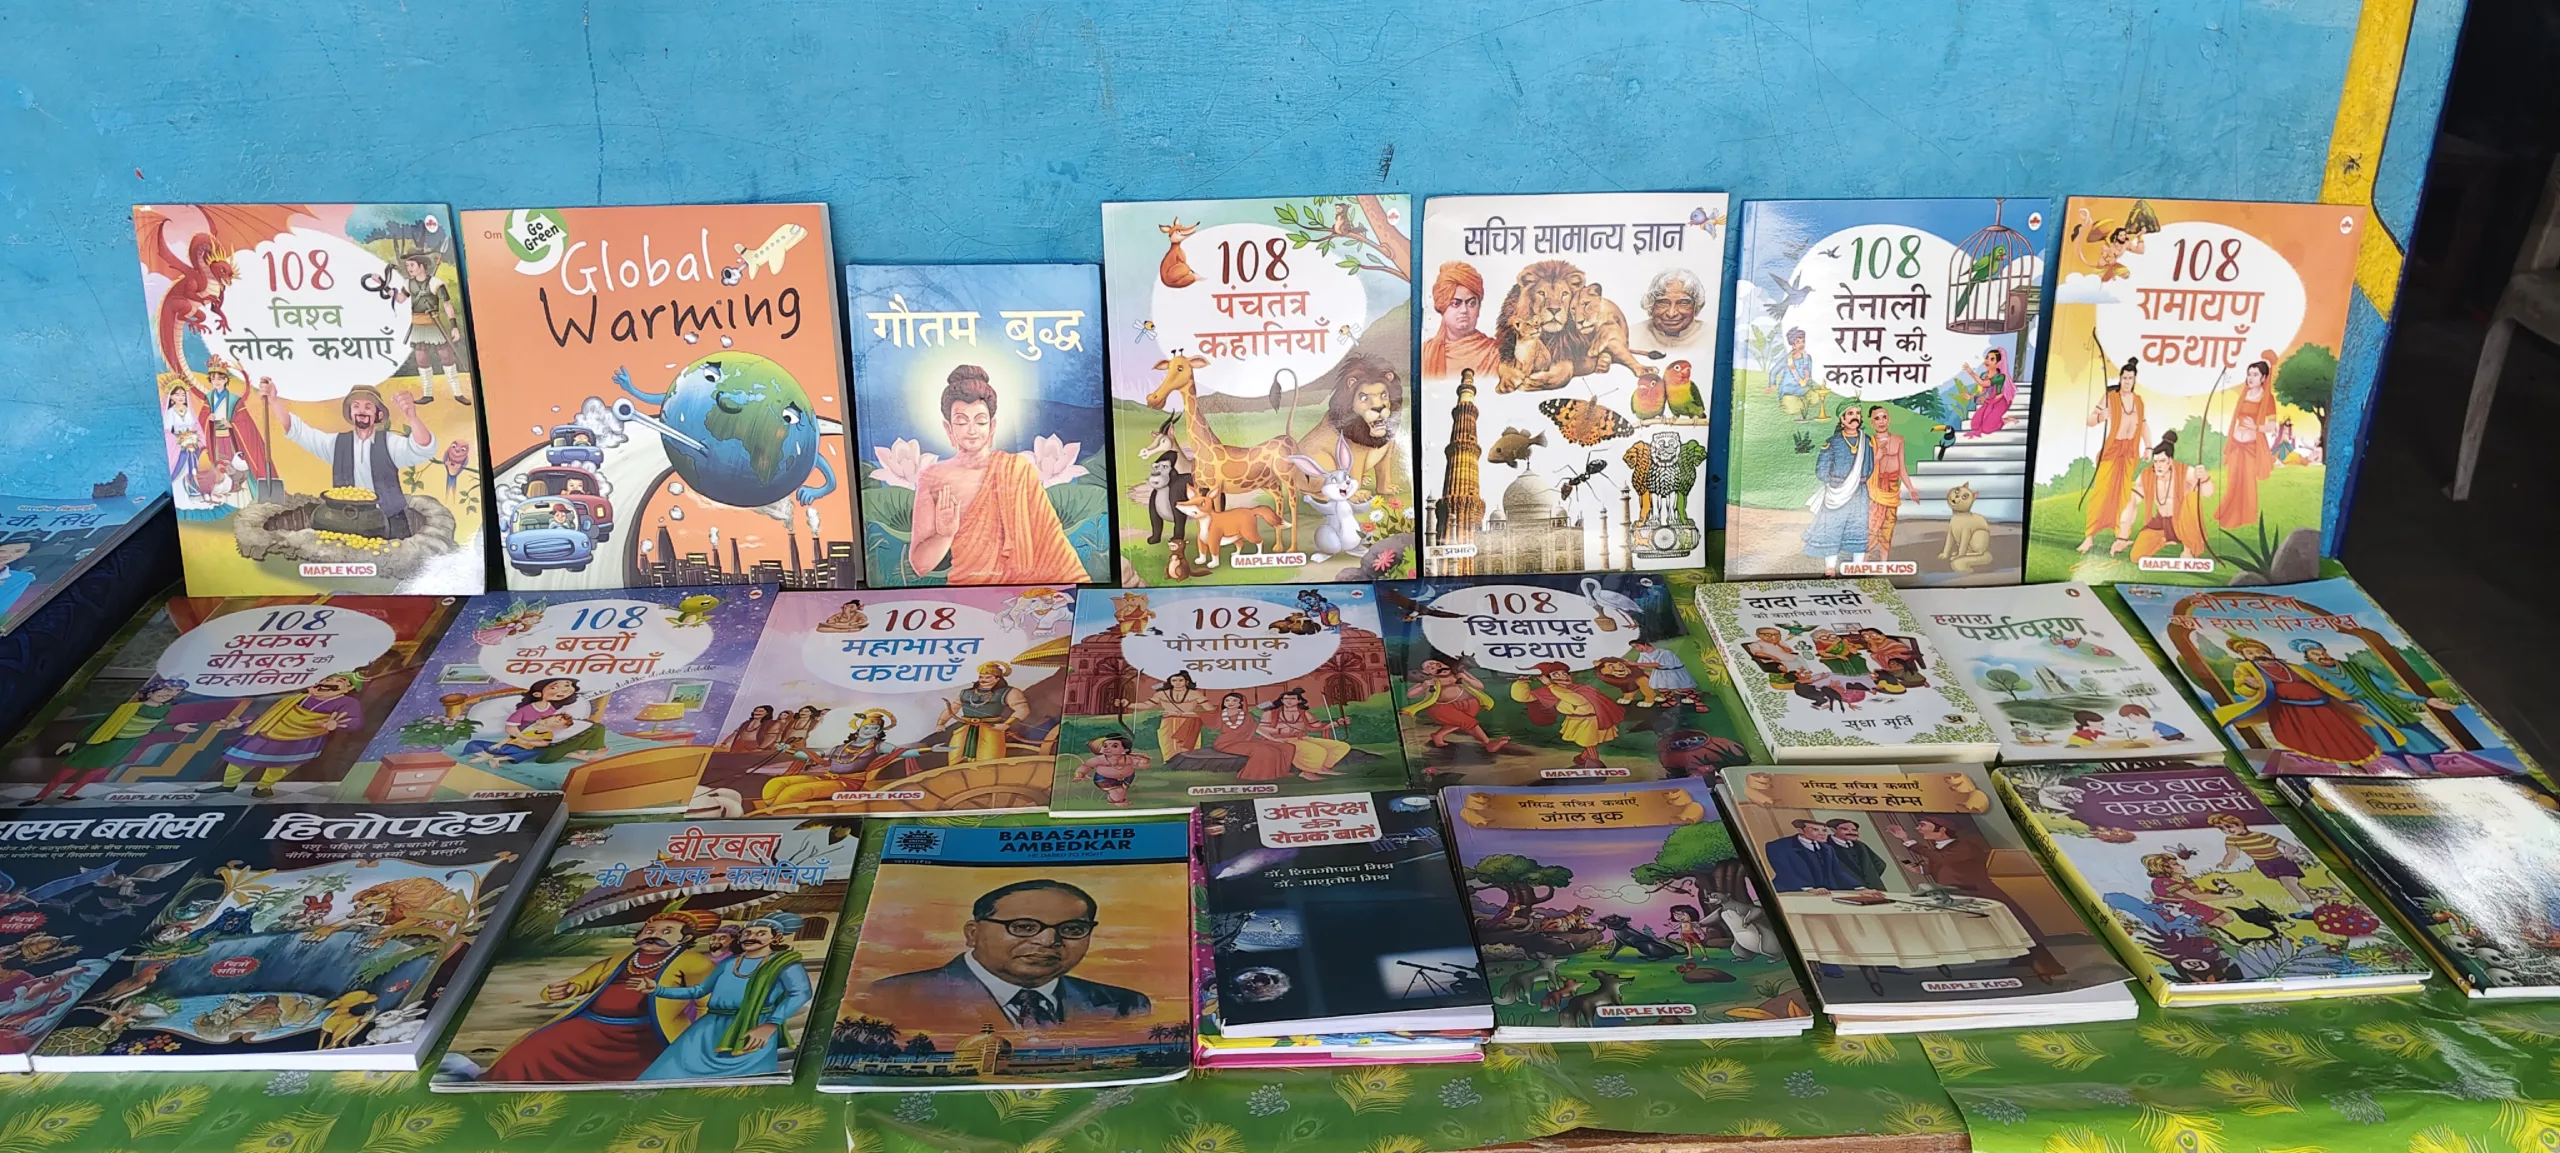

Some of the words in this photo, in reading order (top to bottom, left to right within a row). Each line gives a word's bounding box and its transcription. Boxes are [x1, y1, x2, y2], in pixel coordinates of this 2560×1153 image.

[484, 231, 503, 240] Om
[524, 225, 560, 251] Green
[527, 222, 543, 236] Go
[1464, 216, 1526, 256] सचित्र
[1534, 222, 1626, 255] सामान्य
[1632, 222, 1686, 254] ज्ञान
[560, 227, 714, 297] Global
[1217, 237, 1290, 284] 108
[1850, 234, 1922, 281] 108
[2172, 238, 2242, 283] 108
[262, 249, 336, 293] 108
[1211, 283, 1311, 319] पंचतंत्र
[1833, 282, 1932, 321] तेनाली
[2136, 287, 2265, 323] रामायण
[268, 297, 344, 329] विश्व
[539, 287, 801, 347] Warming
[866, 293, 981, 349] गौतम
[999, 310, 1086, 361] बुद्ध
[1194, 316, 1330, 361] कहानियाँ
[224, 328, 294, 362] लोक
[308, 325, 399, 368] कथाएँ
[1831, 327, 1886, 353] राम
[1894, 326, 1927, 353] की
[2140, 324, 2251, 370] कथाएँ
[1823, 353, 1933, 388] कहानियाँ
[303, 565, 342, 576] MAPLE
[346, 565, 375, 576] KIDS
[1235, 555, 1274, 566] MAPLE
[1276, 554, 1304, 566] KIDS
[1844, 564, 1884, 575] MAPLE
[1886, 564, 1914, 574] KIDS
[2142, 559, 2181, 570] MAPLE
[2184, 560, 2212, 571] KIDS
[1484, 591, 1559, 615] 108
[1744, 589, 1863, 611] दादा-दादी
[2190, 592, 2303, 613] बीरबल
[257, 609, 336, 633] 108
[570, 605, 649, 631] 108
[885, 607, 957, 633] 108
[1192, 606, 1261, 631] 108
[1464, 614, 1596, 637] शिक्षाप्रद
[1931, 614, 1994, 627] हमारा
[1951, 616, 2088, 641] पर्यावरण
[2207, 617, 2259, 632] हास
[2260, 614, 2362, 632] परिहास
[224, 632, 339, 650] अकबर
[516, 645, 549, 657] की
[555, 631, 638, 653] बच्चों
[842, 637, 985, 657] महाभारत
[1163, 633, 1292, 652] पौराणिक
[1484, 636, 1589, 659] कथाएँ
[206, 650, 307, 670] बीरबल
[312, 654, 335, 665] की
[505, 651, 664, 676] कहानियाँ
[851, 658, 966, 683] कथाएँ
[1182, 652, 1273, 676] कथाएँ
[195, 667, 318, 688] कहानियाँ
[1841, 718, 1877, 732] सुधा
[1883, 714, 1914, 729] मूर्ति
[1545, 769, 1591, 779] MAPLE
[1594, 768, 1628, 778] KIDS
[836, 792, 883, 801] MAPLE
[887, 791, 922, 800] KIDS
[1192, 786, 1239, 795] MAPLE
[1242, 784, 1275, 794] KIDS
[1800, 781, 1838, 791] प्रसिद्ध
[1843, 780, 1879, 791] सचित्र
[1884, 779, 1923, 792] कथाएँ
[2086, 777, 2164, 797] श्रेष्ठ
[2166, 777, 2236, 796] बाल
[109, 793, 158, 802] MAPLE
[160, 793, 197, 801] KIDS
[1518, 799, 1556, 811] प्रसिद्ध
[1560, 798, 1596, 810] सचित्र
[1603, 796, 1640, 808] कथाएँ
[1882, 793, 1923, 808] होम्स
[2100, 791, 2258, 817] कहानियाँ
[1264, 800, 1368, 820] अंतरिक्ष
[1539, 811, 1585, 824] जंगल
[1590, 810, 1624, 824] बुक
[91, 812, 225, 840] बत्तीसी
[260, 811, 533, 841] हितोपदेश
[1000, 828, 1135, 842] BABASAHEB
[1269, 829, 1330, 844] रोचक
[1332, 824, 1376, 841] बातें
[1300, 818, 1341, 829] की
[666, 827, 783, 861] बीरबल
[1000, 840, 1131, 853] AMBEDKAR
[596, 864, 629, 889] की
[644, 861, 714, 887] रोचक
[726, 857, 832, 888] कहानियाँ
[1928, 981, 1979, 990] MAPLE
[1983, 979, 2019, 989] KIDS
[1602, 1007, 1652, 1016] MAPLE
[1657, 1005, 1693, 1015] KIDS
